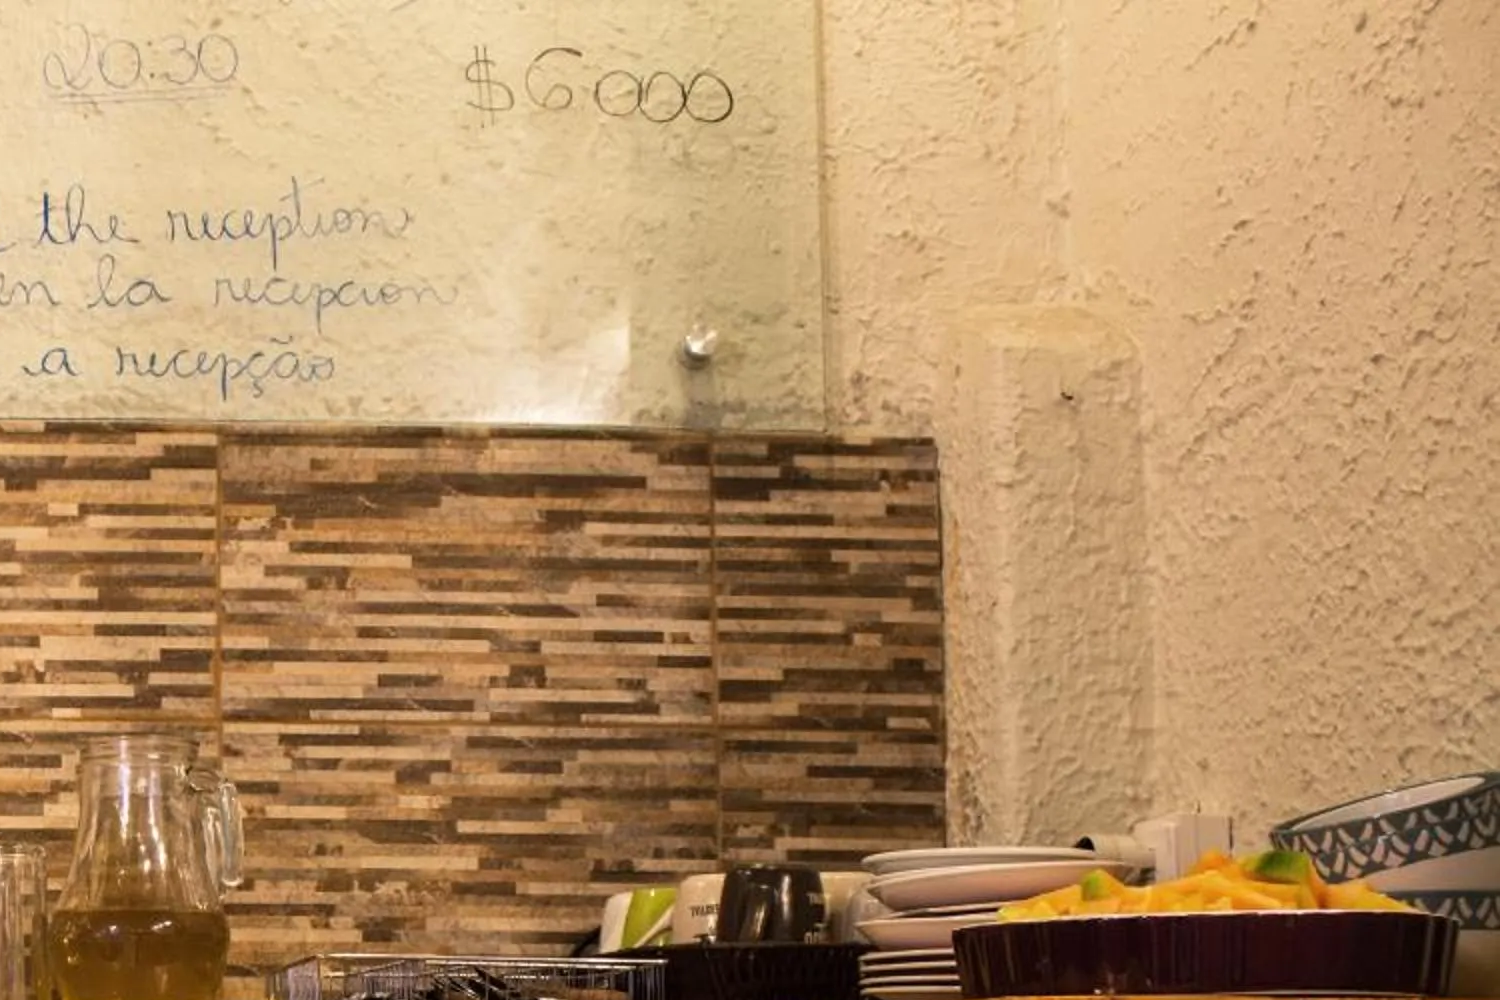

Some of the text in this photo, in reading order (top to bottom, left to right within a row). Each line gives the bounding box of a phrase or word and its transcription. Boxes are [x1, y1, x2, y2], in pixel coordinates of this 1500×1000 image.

[43, 23, 239, 91] 20:30
[464, 45, 733, 127] $6000
[29, 183, 140, 246] the
[166, 176, 414, 272] reception
[86, 254, 173, 309] la
[21, 346, 80, 378] a
[114, 335, 336, 402] recepção
